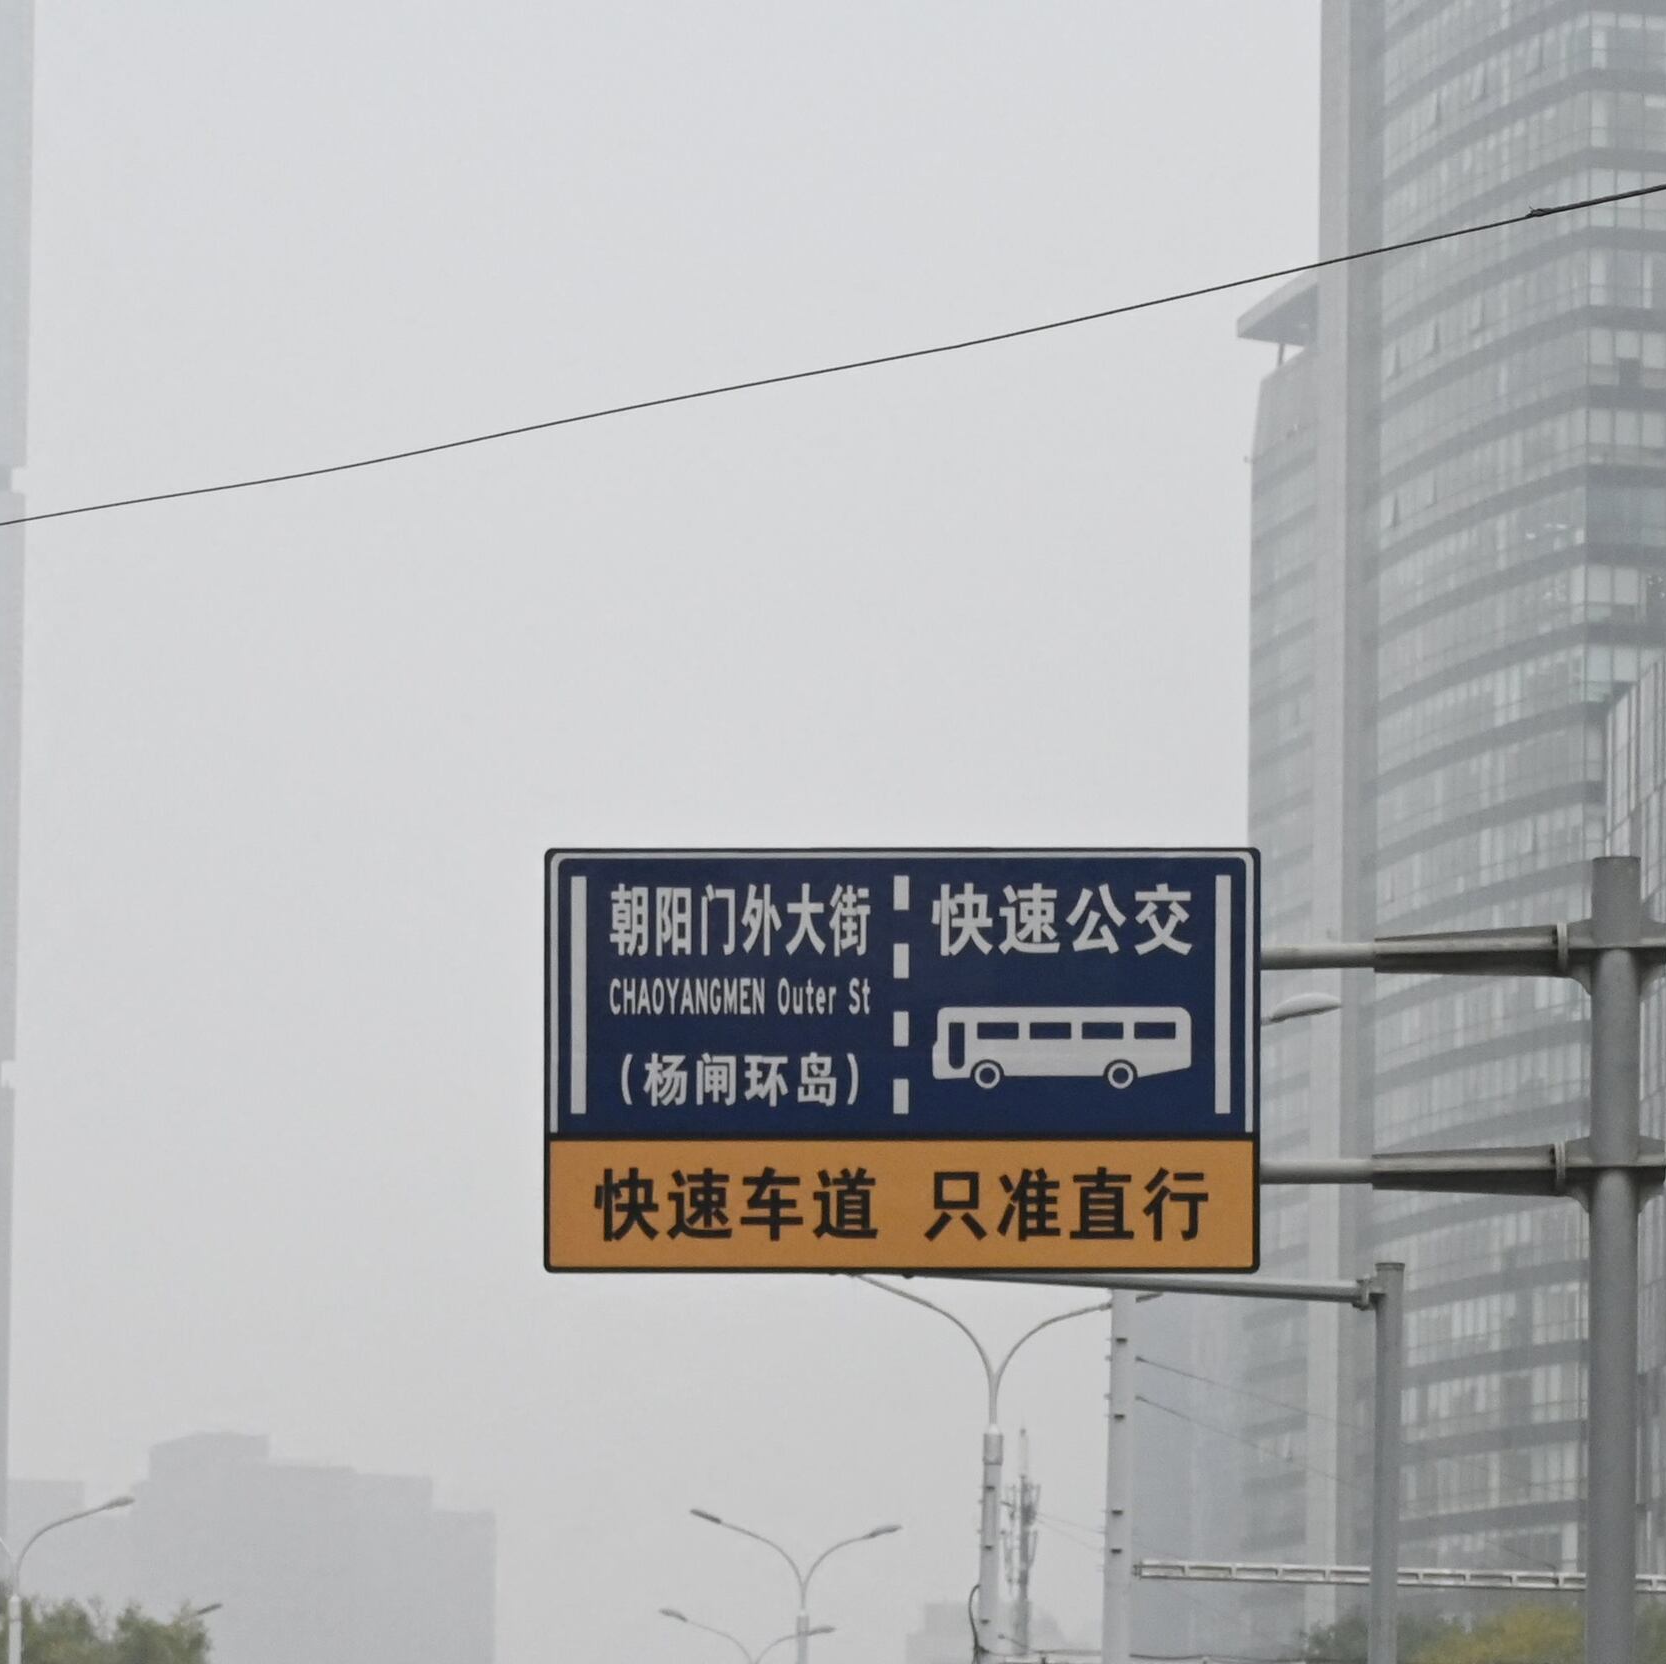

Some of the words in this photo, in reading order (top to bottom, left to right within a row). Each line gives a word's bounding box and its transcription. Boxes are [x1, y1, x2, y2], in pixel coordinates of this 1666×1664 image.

[609, 882, 871, 957] 朝阳门外大街
[931, 882, 1193, 957] 快速公交
[609, 977, 765, 1015] CHAOYANGMEN
[777, 977, 837, 1015] Outer
[848, 977, 871, 1015] St
[621, 1051, 859, 1107] (杨闸环岛)
[594, 1166, 879, 1242] 快速车道
[924, 1166, 1209, 1242] 只准直行
